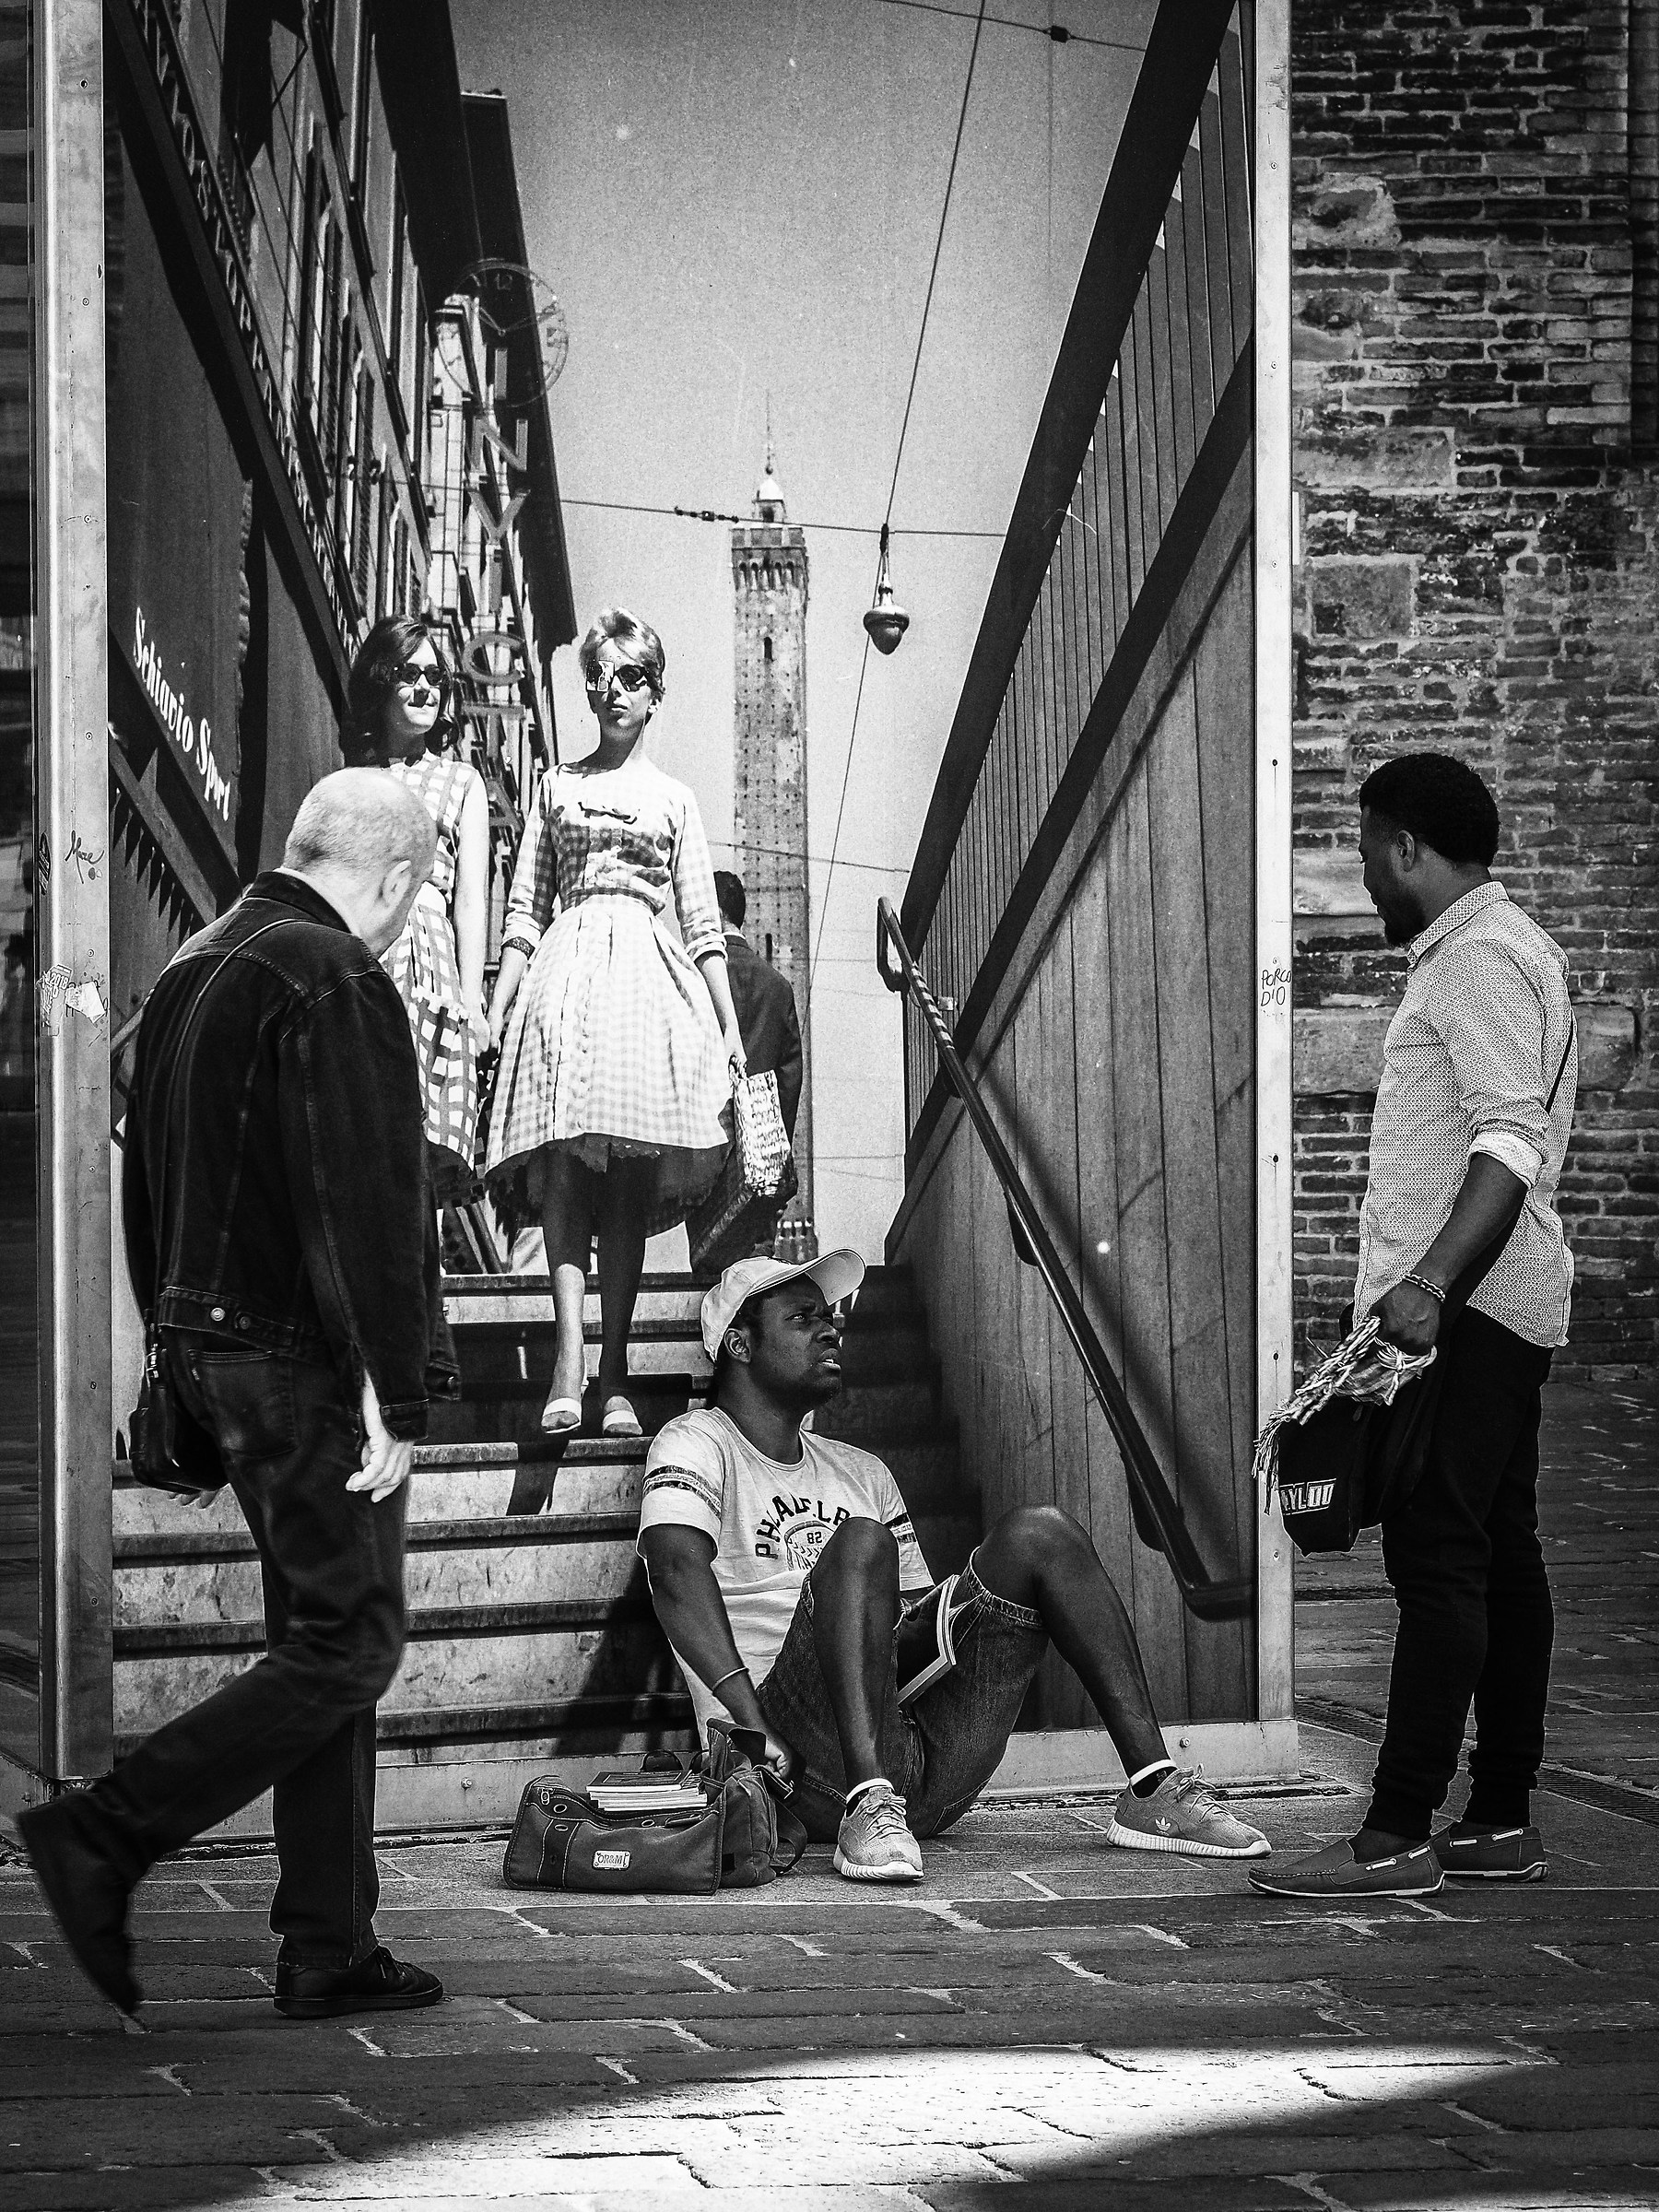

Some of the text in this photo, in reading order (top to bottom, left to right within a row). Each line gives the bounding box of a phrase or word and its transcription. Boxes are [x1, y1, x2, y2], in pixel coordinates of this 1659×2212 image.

[133, 606, 194, 752] Schiavio
[1261, 968, 1292, 990] PORCO
[806, 1531, 823, 1545] 82
